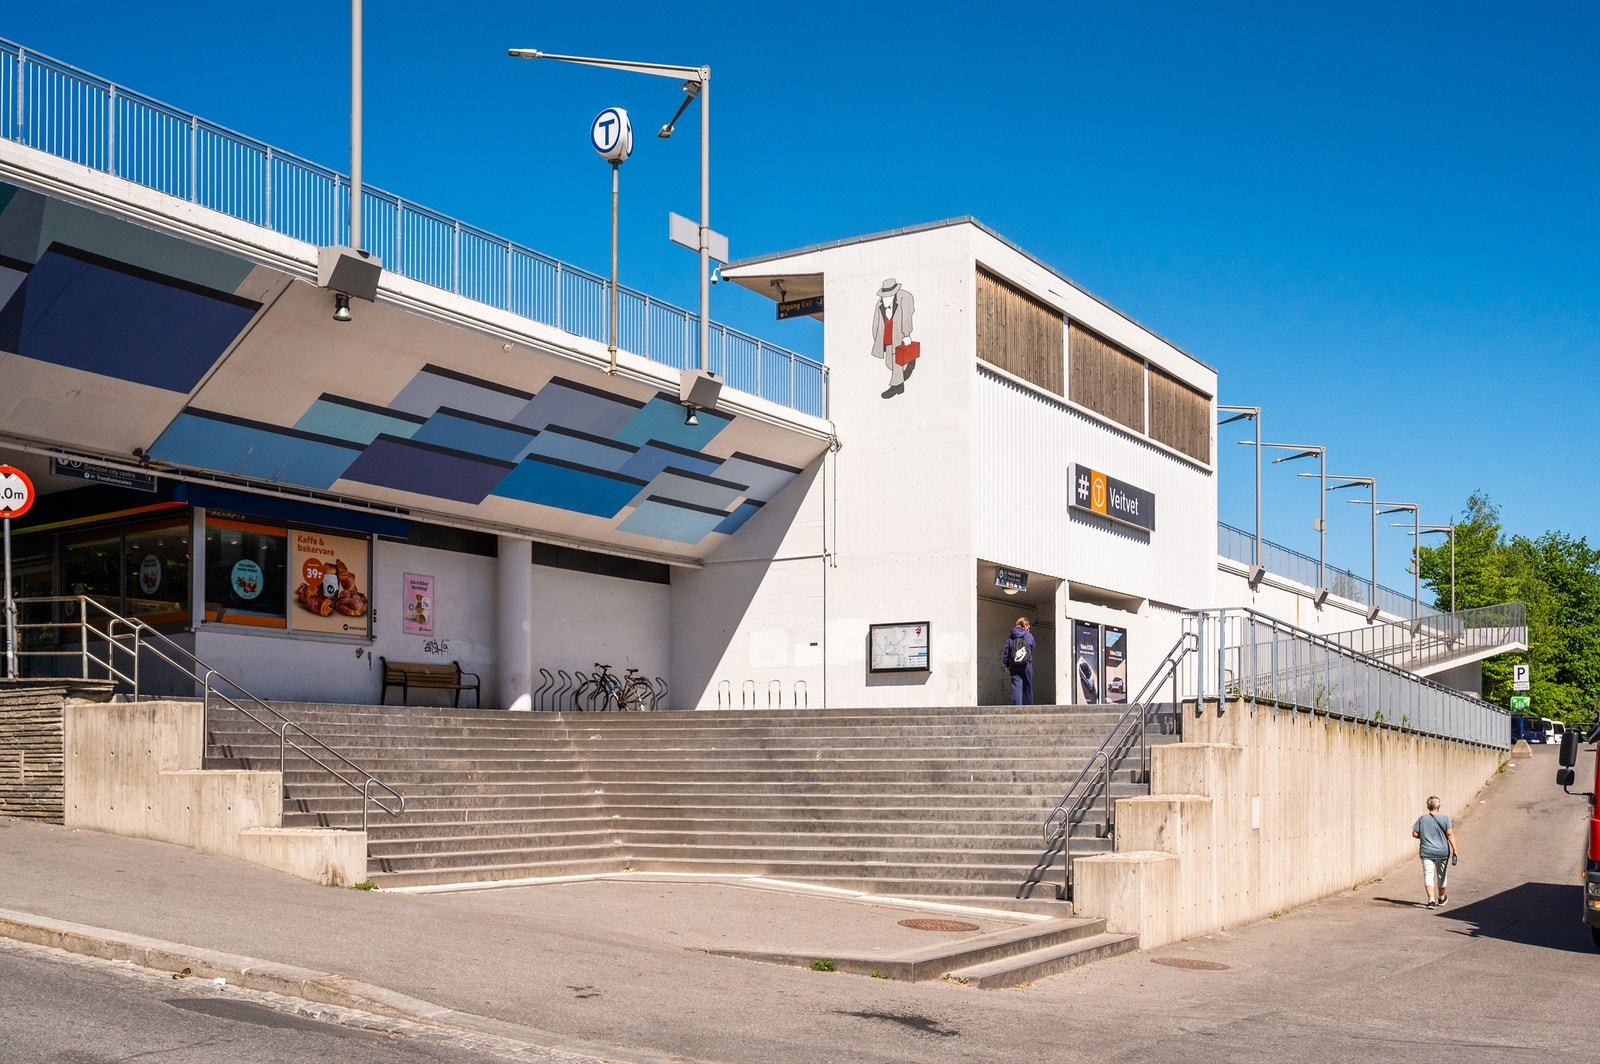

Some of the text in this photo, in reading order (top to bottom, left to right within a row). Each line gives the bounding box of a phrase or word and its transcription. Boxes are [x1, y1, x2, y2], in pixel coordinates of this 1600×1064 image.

[599, 118, 615, 146] T
[84, 463, 136, 479] Direction city centre
[0, 487, 24, 500] ,0m
[1109, 486, 1139, 516] Veitvet
[297, 534, 325, 546] Kaffe &
[297, 543, 335, 556] bakervare
[1517, 667, 1526, 680] P
